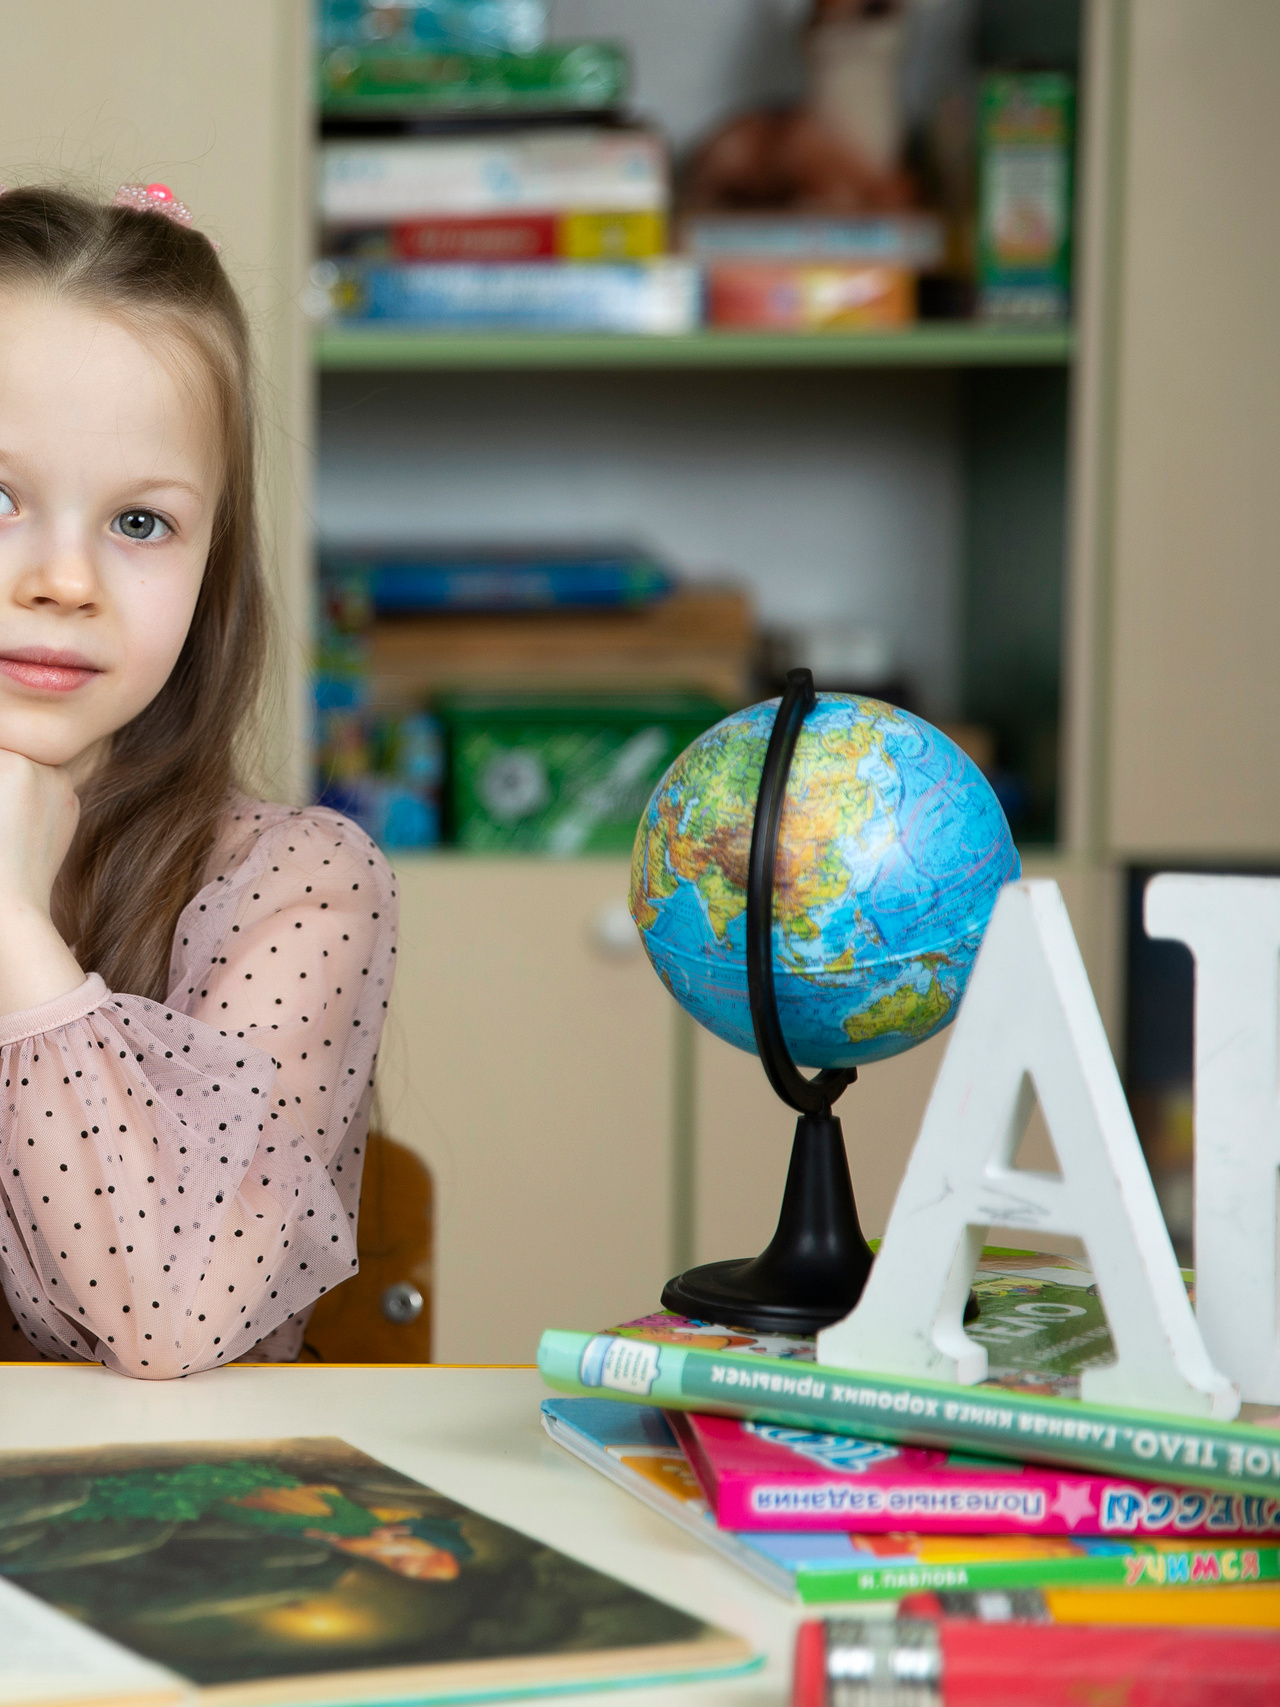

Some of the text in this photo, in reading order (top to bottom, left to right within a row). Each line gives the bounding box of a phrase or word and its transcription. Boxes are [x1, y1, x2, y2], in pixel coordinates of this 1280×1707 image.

[710, 1363, 1280, 1478] ОЁ ТЕЛО. Главная книга хороших привычек
[755, 1486, 1042, 1517] Полезные задания
[1125, 1551, 1261, 1586] УЧИМСЯ
